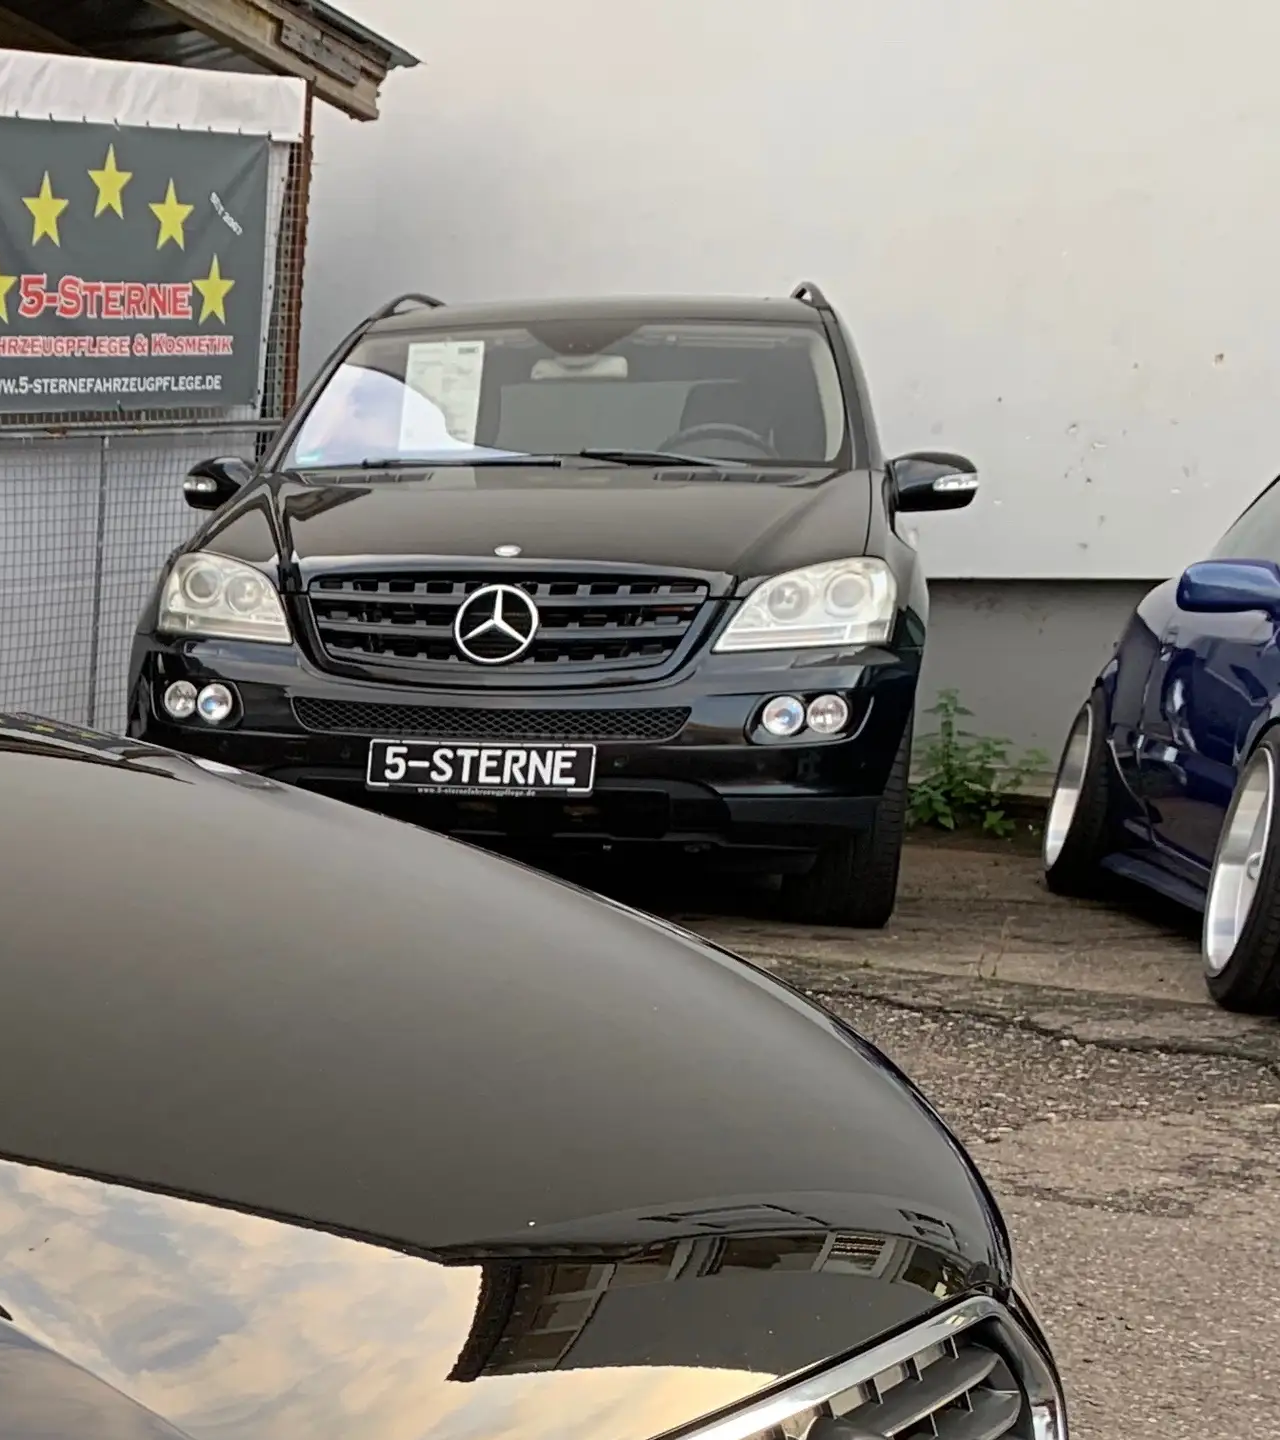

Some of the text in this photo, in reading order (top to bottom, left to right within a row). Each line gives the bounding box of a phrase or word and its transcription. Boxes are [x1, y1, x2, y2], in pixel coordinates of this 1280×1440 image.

[18, 274, 193, 320] 5-STERNE
[132, 334, 149, 357] &
[151, 332, 234, 356] KOSMETIK
[384, 745, 578, 786] 5-STERNE
